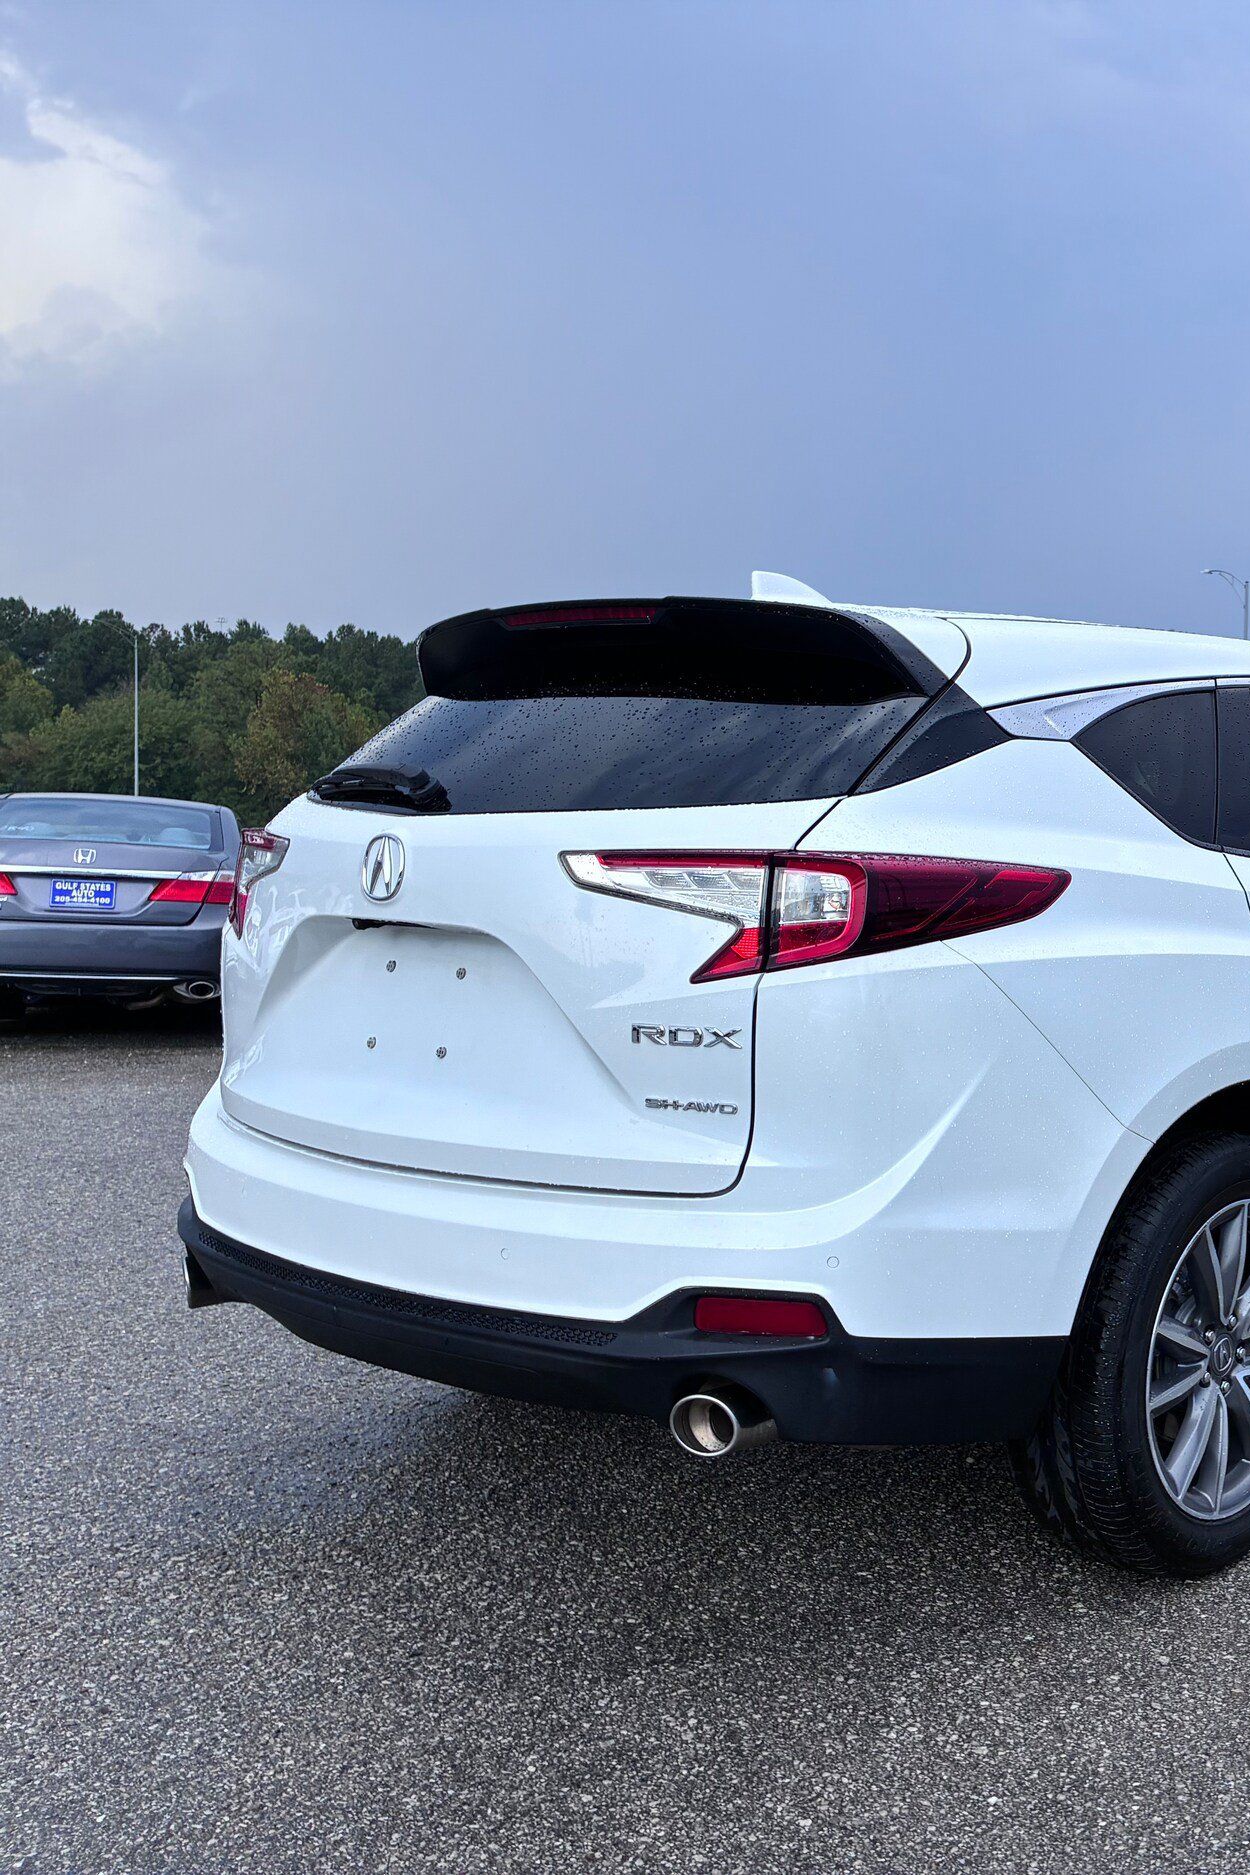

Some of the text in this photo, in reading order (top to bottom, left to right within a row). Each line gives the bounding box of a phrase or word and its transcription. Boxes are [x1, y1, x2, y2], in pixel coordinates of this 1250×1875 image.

[55, 882, 111, 892] GULF STATES
[71, 889, 95, 897] AUTO
[631, 1023, 743, 1050] RDX
[644, 1098, 739, 1115] SH-AWD
